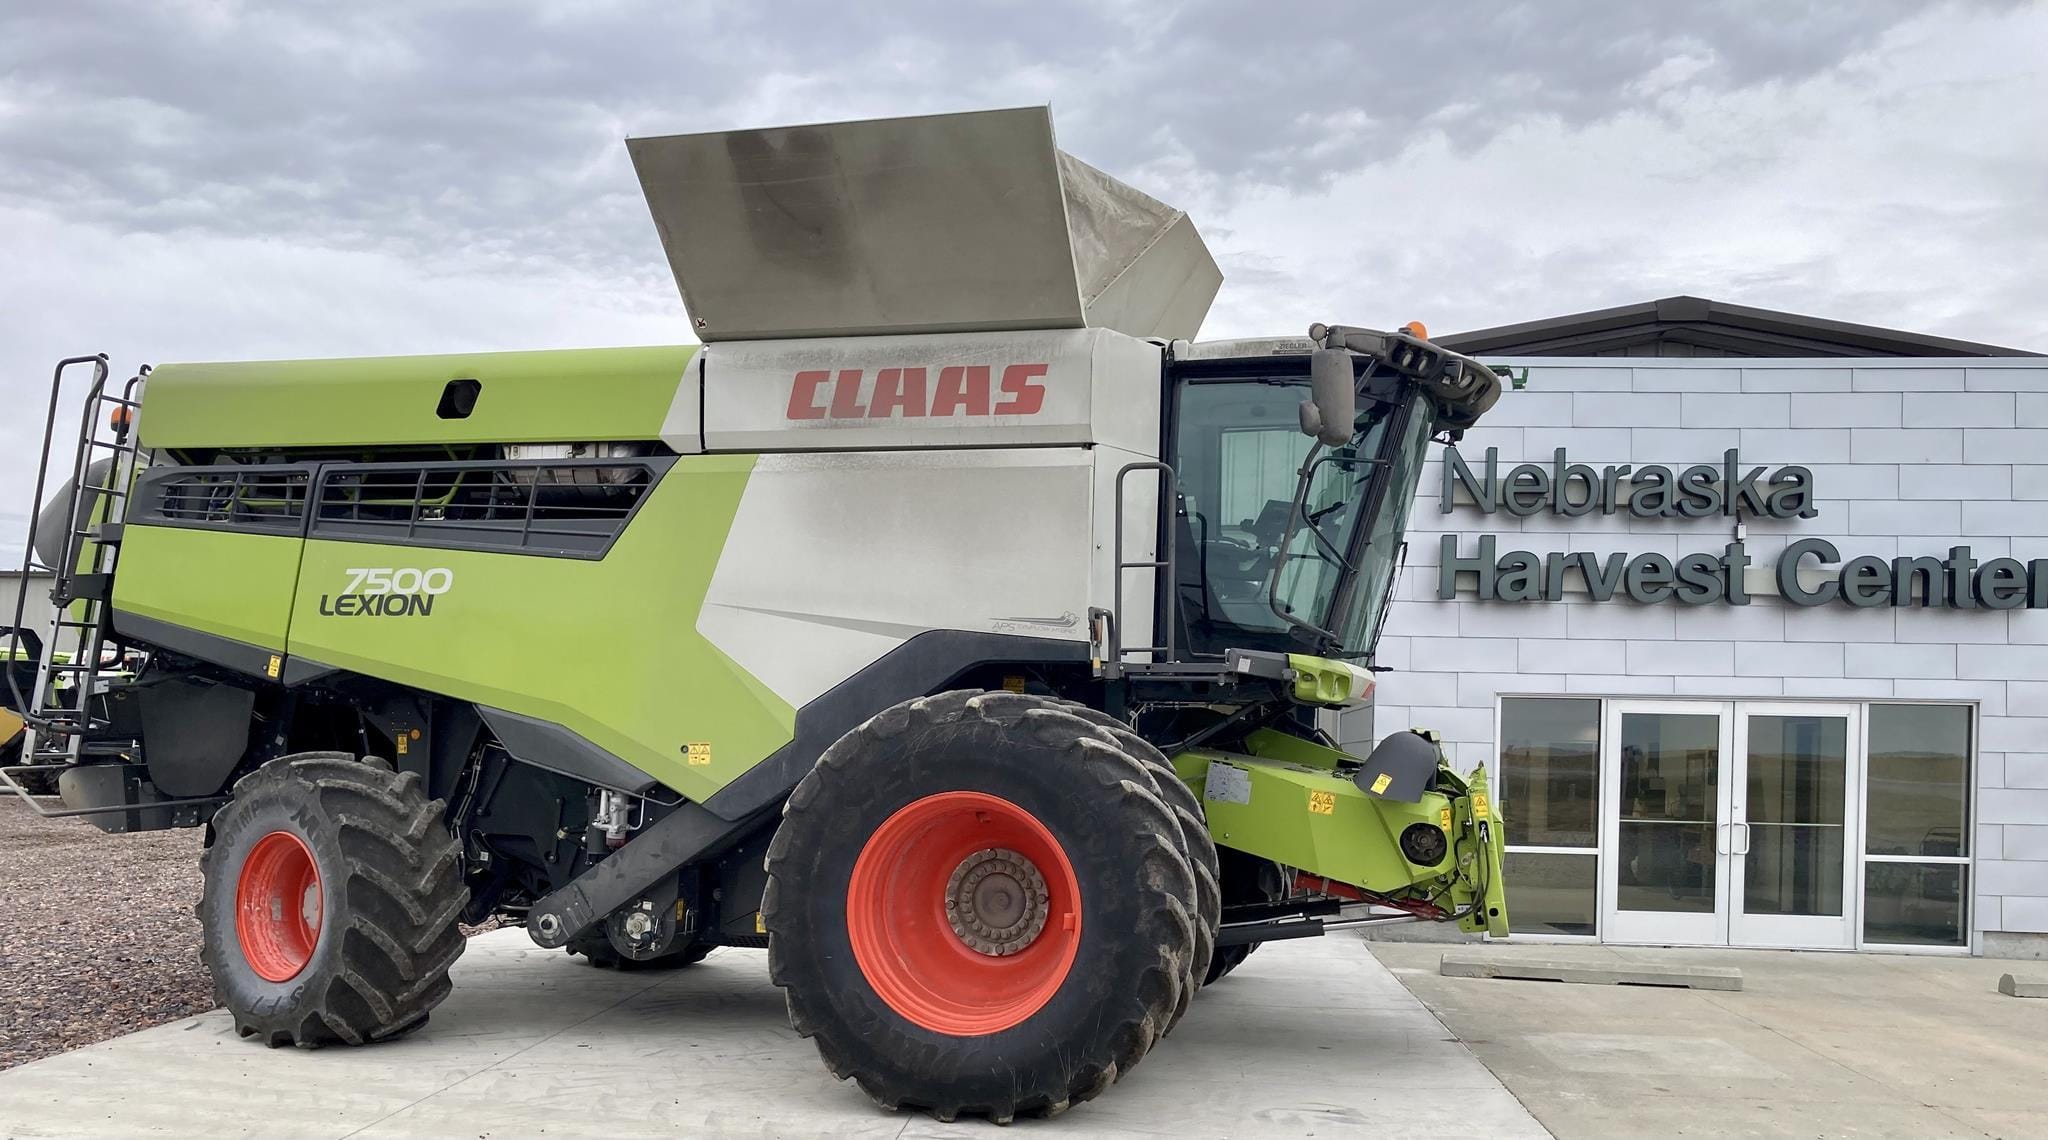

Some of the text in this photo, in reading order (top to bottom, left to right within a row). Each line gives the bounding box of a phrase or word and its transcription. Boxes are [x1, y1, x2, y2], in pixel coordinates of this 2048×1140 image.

[1279, 342, 1308, 350] ZIEGLER
[786, 364, 1049, 420] CLAAS
[1440, 447, 1819, 519] Nebraska
[342, 568, 453, 594] 7500
[1439, 535, 1751, 605] Harvest
[320, 594, 434, 616] LEXION
